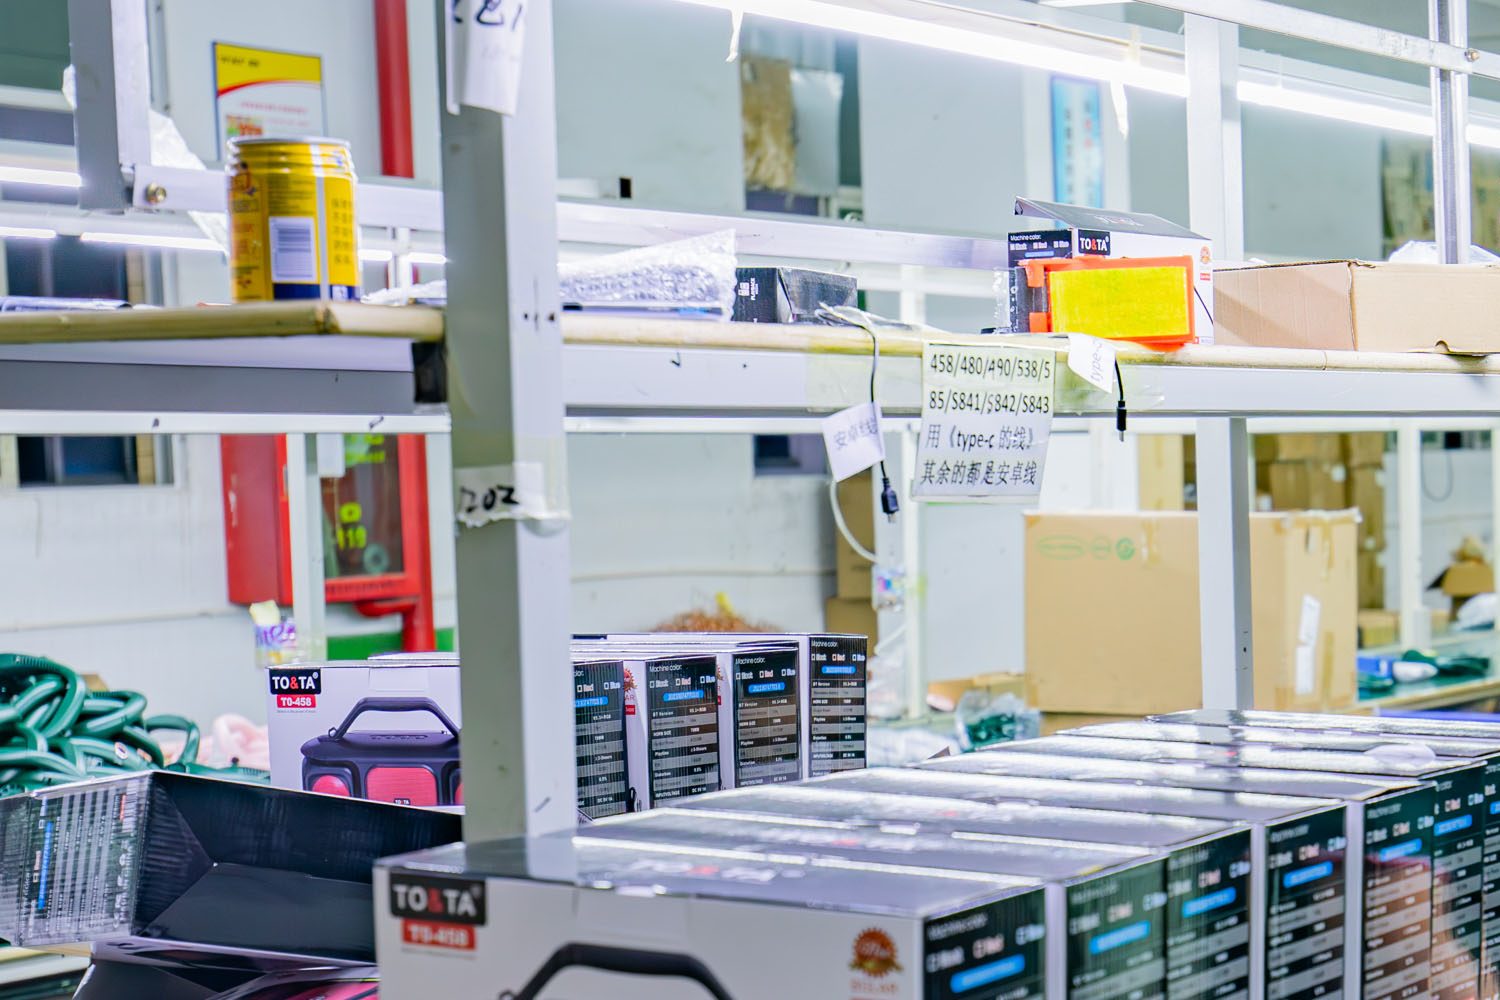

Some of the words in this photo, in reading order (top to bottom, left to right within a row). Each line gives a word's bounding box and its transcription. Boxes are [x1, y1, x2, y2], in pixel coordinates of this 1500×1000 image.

[1079, 236, 1108, 252] TO&TA
[930, 352, 1051, 382] 458/480/490/538/5
[929, 389, 1050, 416] 85/S841/S842/S843
[920, 460, 1038, 486] 其余的都是安卓线
[271, 675, 316, 690] TO&TA
[393, 884, 477, 917] TO&TA
